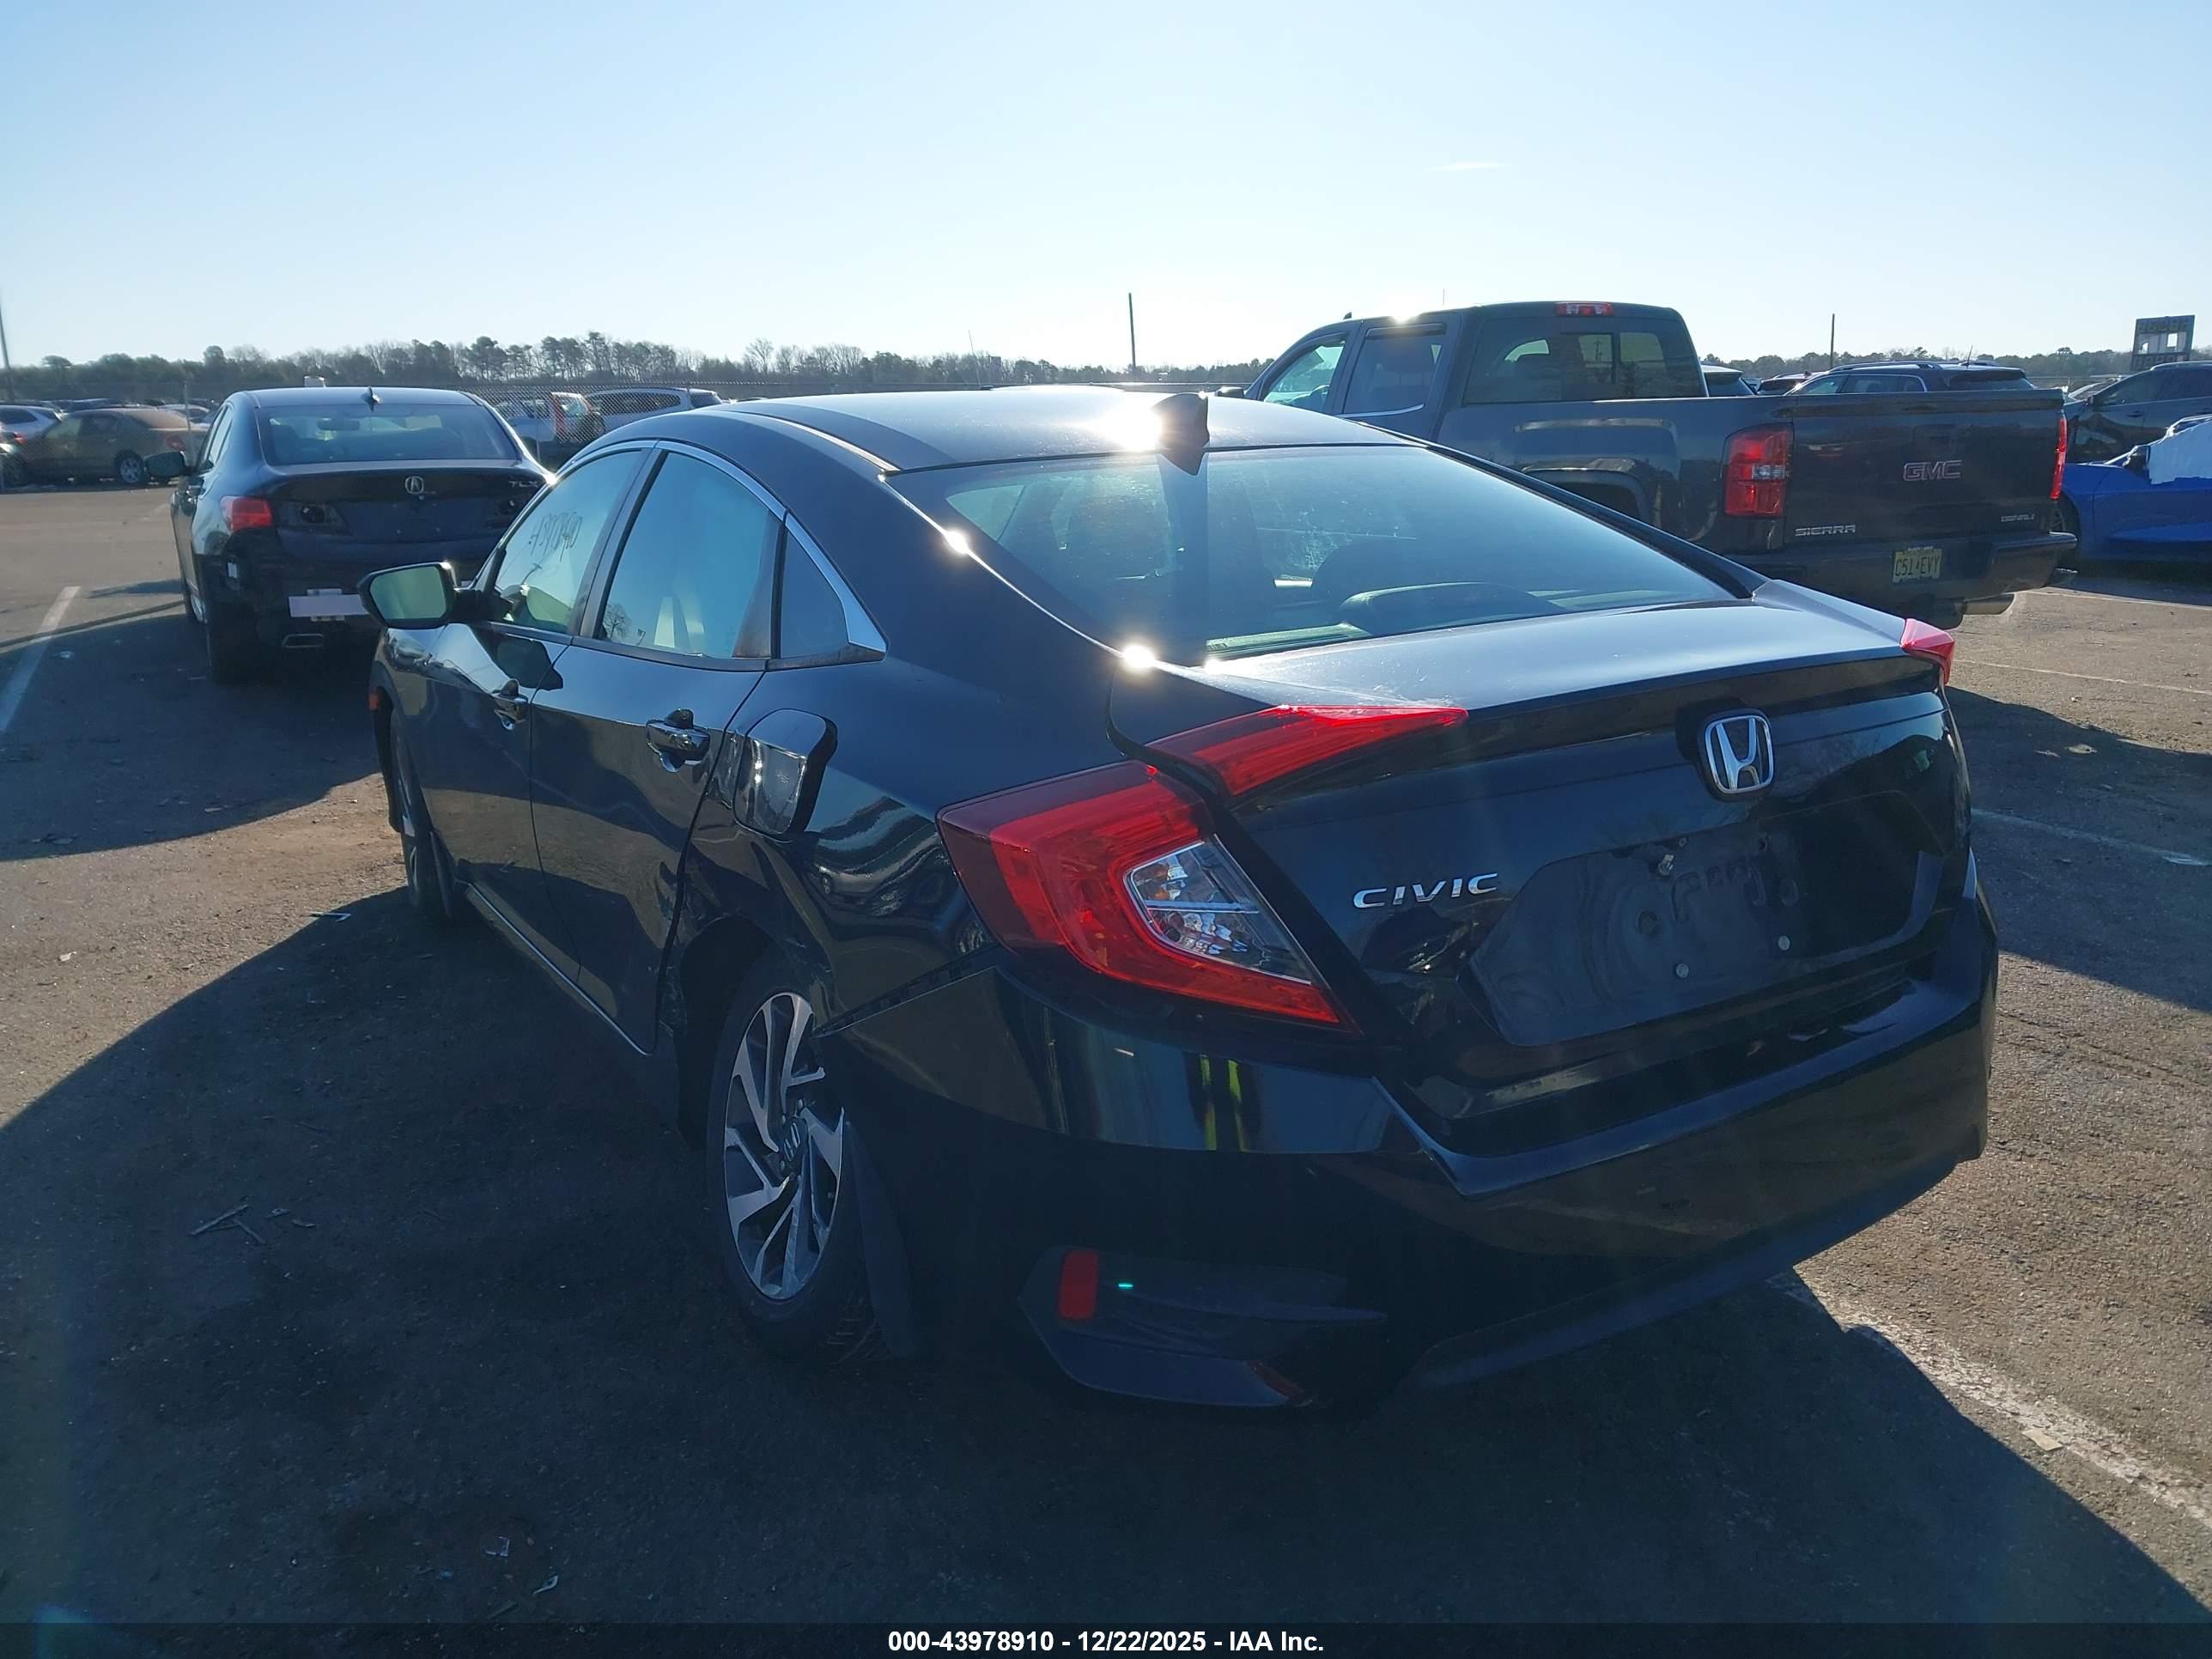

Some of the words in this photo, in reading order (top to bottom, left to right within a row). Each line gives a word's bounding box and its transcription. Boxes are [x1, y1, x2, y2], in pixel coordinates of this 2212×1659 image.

[1903, 459, 1963, 482] GMC
[1795, 524, 1856, 537] SIERRA
[1352, 872, 1498, 908] CIVIC
